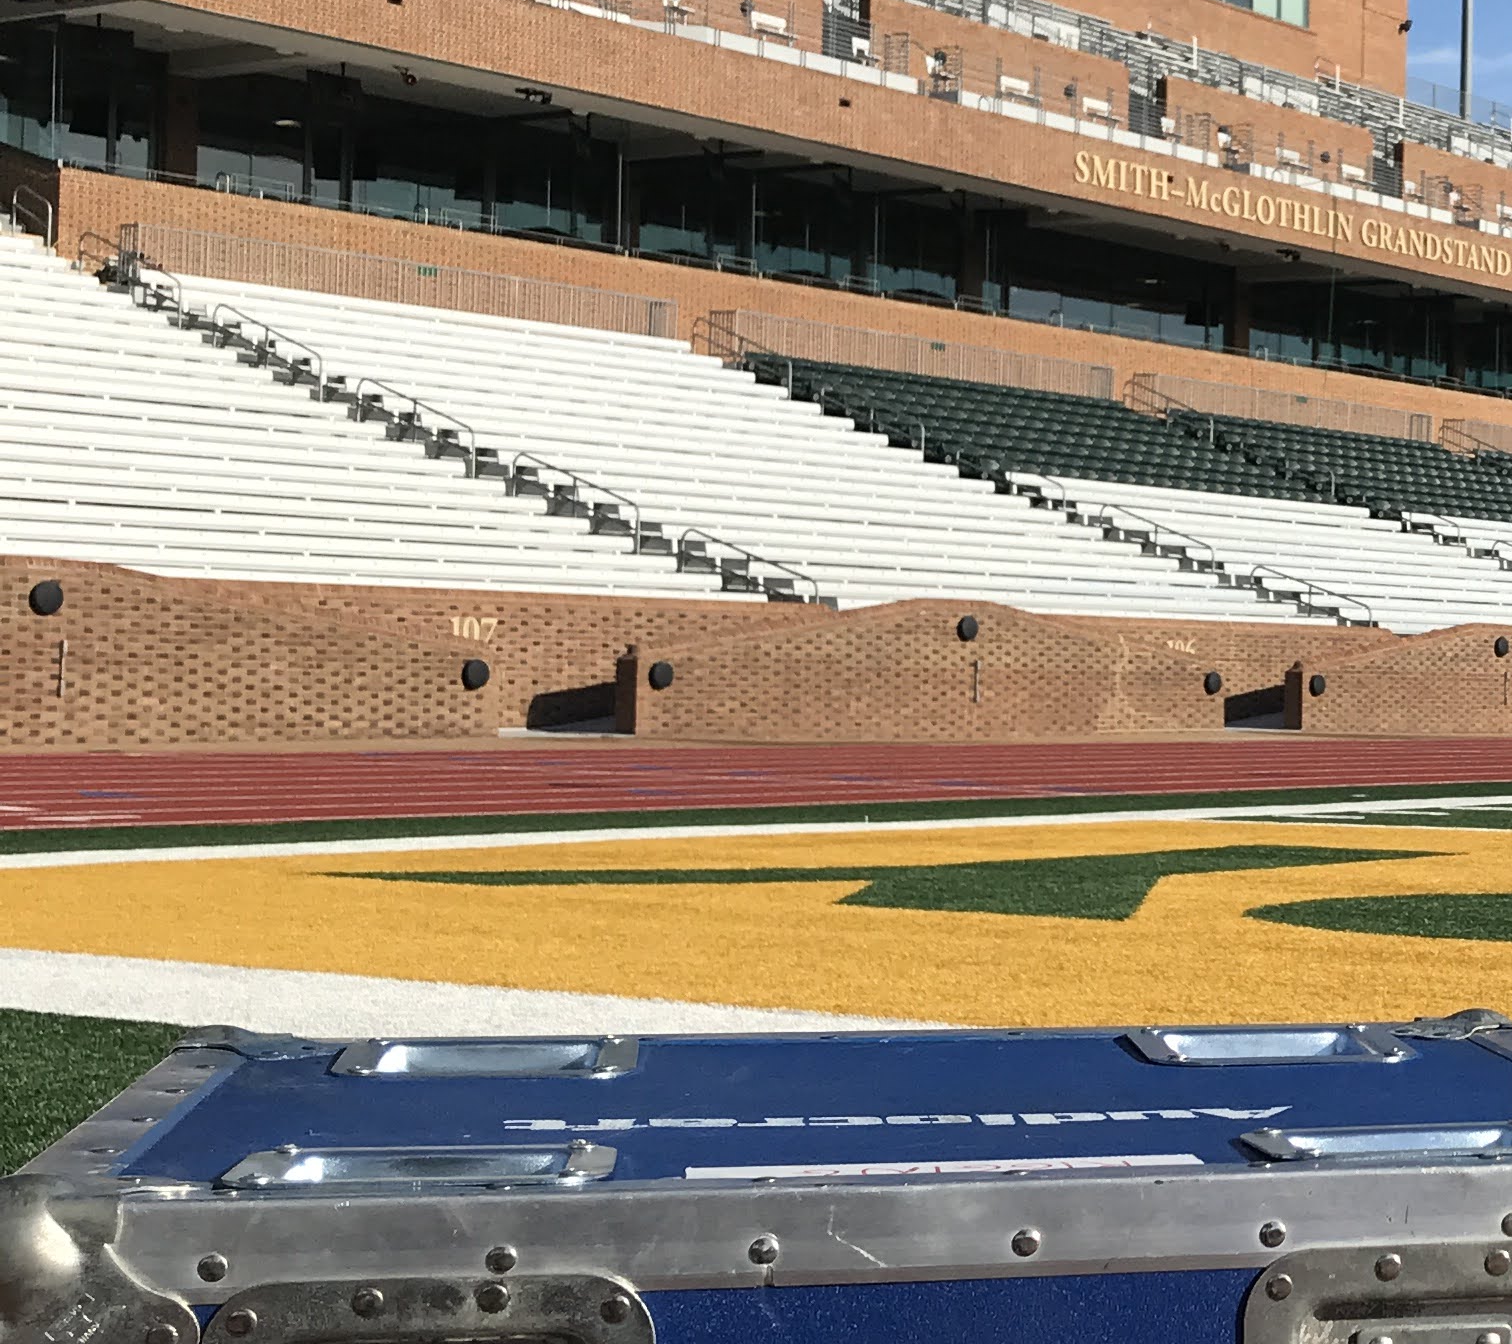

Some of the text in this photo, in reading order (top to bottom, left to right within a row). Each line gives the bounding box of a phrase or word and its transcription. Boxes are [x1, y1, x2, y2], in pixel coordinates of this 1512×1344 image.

[1361, 218, 1512, 277] GRANDSTAND
[451, 616, 498, 643] 107
[503, 1105, 1293, 1131] Audiocraft
